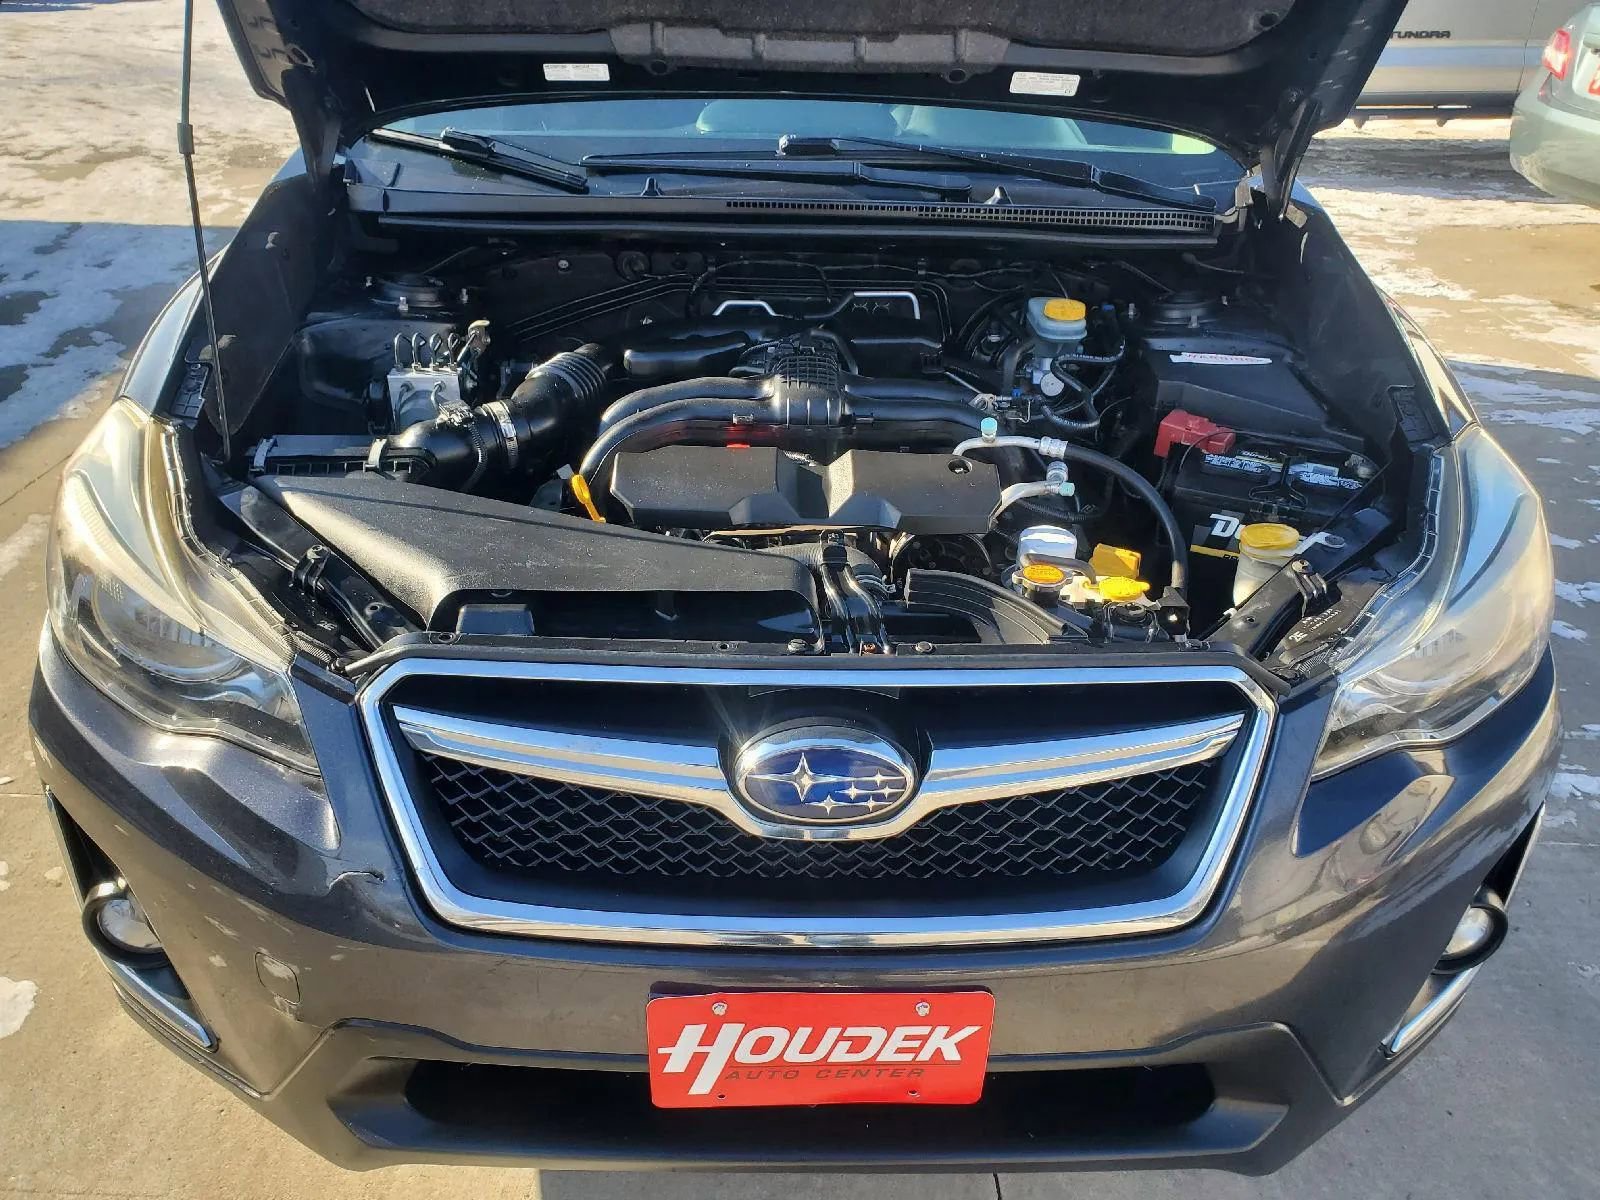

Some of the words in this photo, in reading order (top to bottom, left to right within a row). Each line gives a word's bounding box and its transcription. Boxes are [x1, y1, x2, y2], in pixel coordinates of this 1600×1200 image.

[1390, 30, 1451, 39] TUNDRA
[657, 1023, 982, 1095] HOUDEK
[724, 1068, 799, 1081] AUTO
[815, 1068, 926, 1080] CENTER
